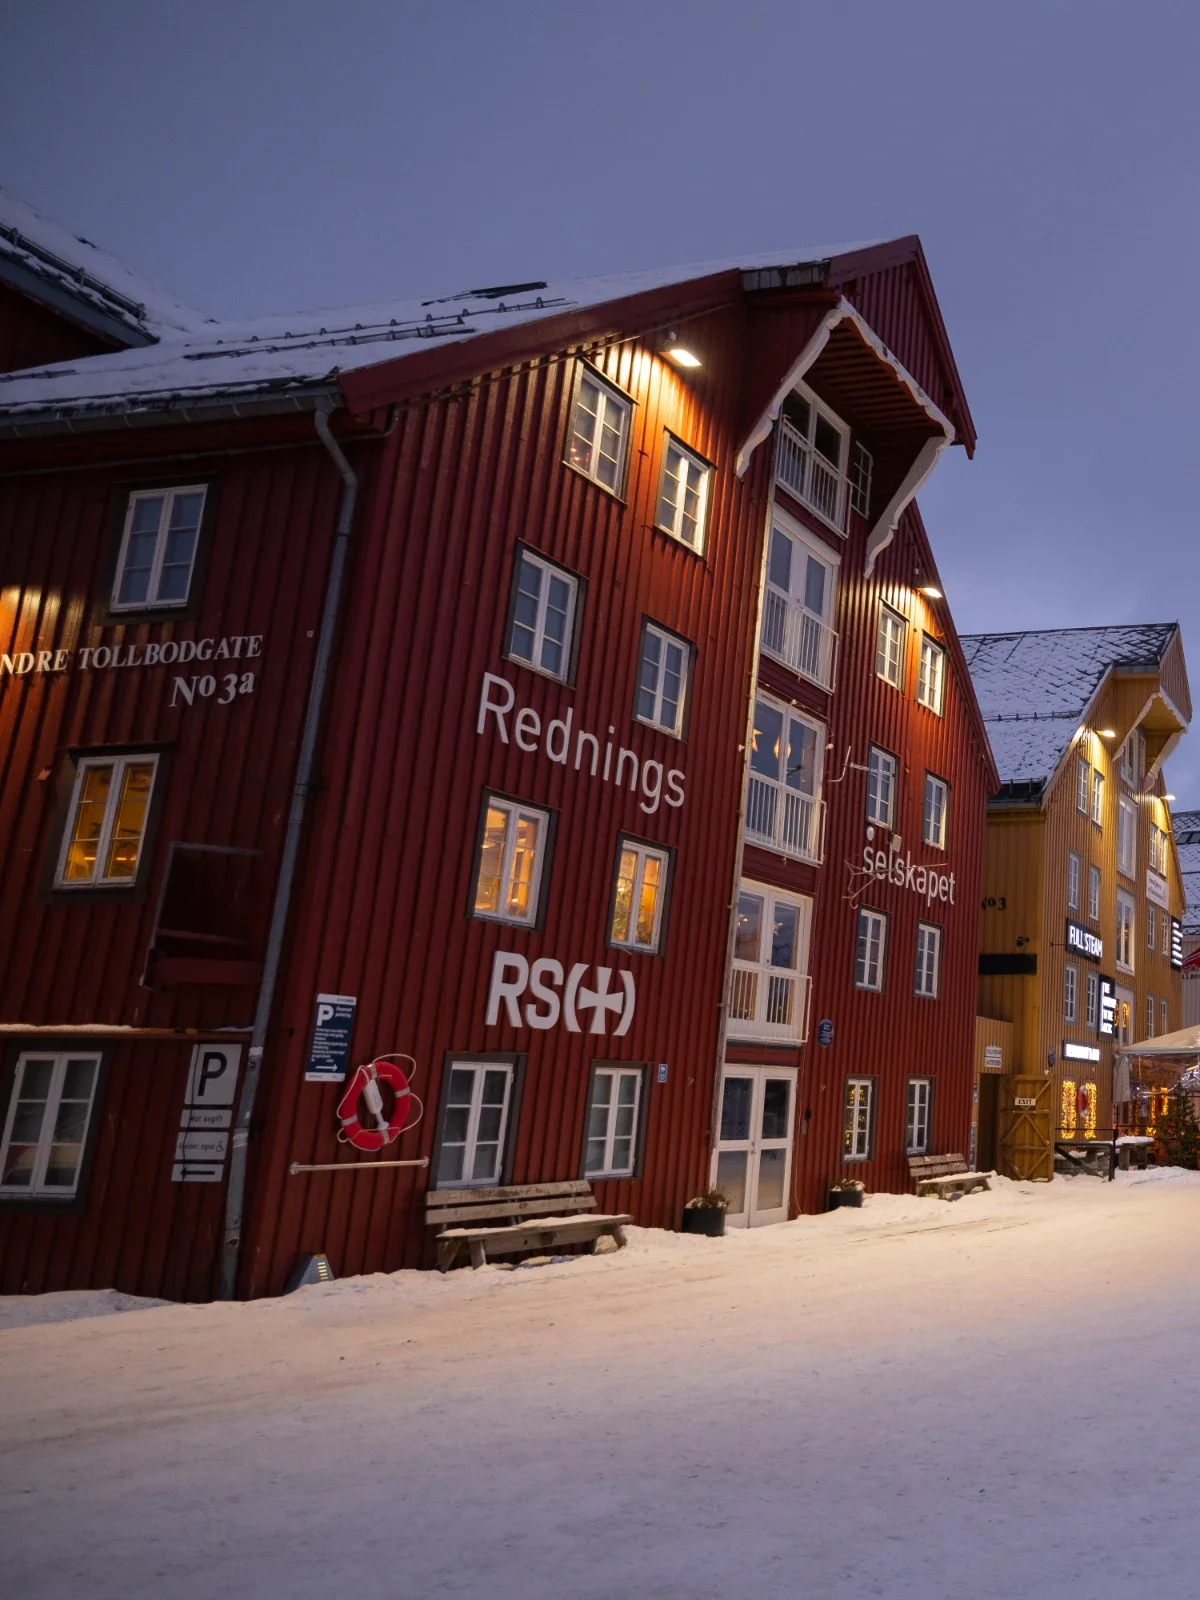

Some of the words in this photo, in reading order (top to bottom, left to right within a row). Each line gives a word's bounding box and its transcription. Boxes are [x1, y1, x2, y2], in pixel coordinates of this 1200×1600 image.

[79, 635, 263, 669] TOLLBODGATE
[477, 671, 686, 815] Rednings
[862, 843, 956, 908] selskapet
[1069, 925, 1084, 950] FULL
[1083, 932, 1103, 958] STEAM
[316, 1004, 335, 1027] P
[197, 1051, 228, 1097] P
[1018, 1098, 1033, 1106] EXIT
